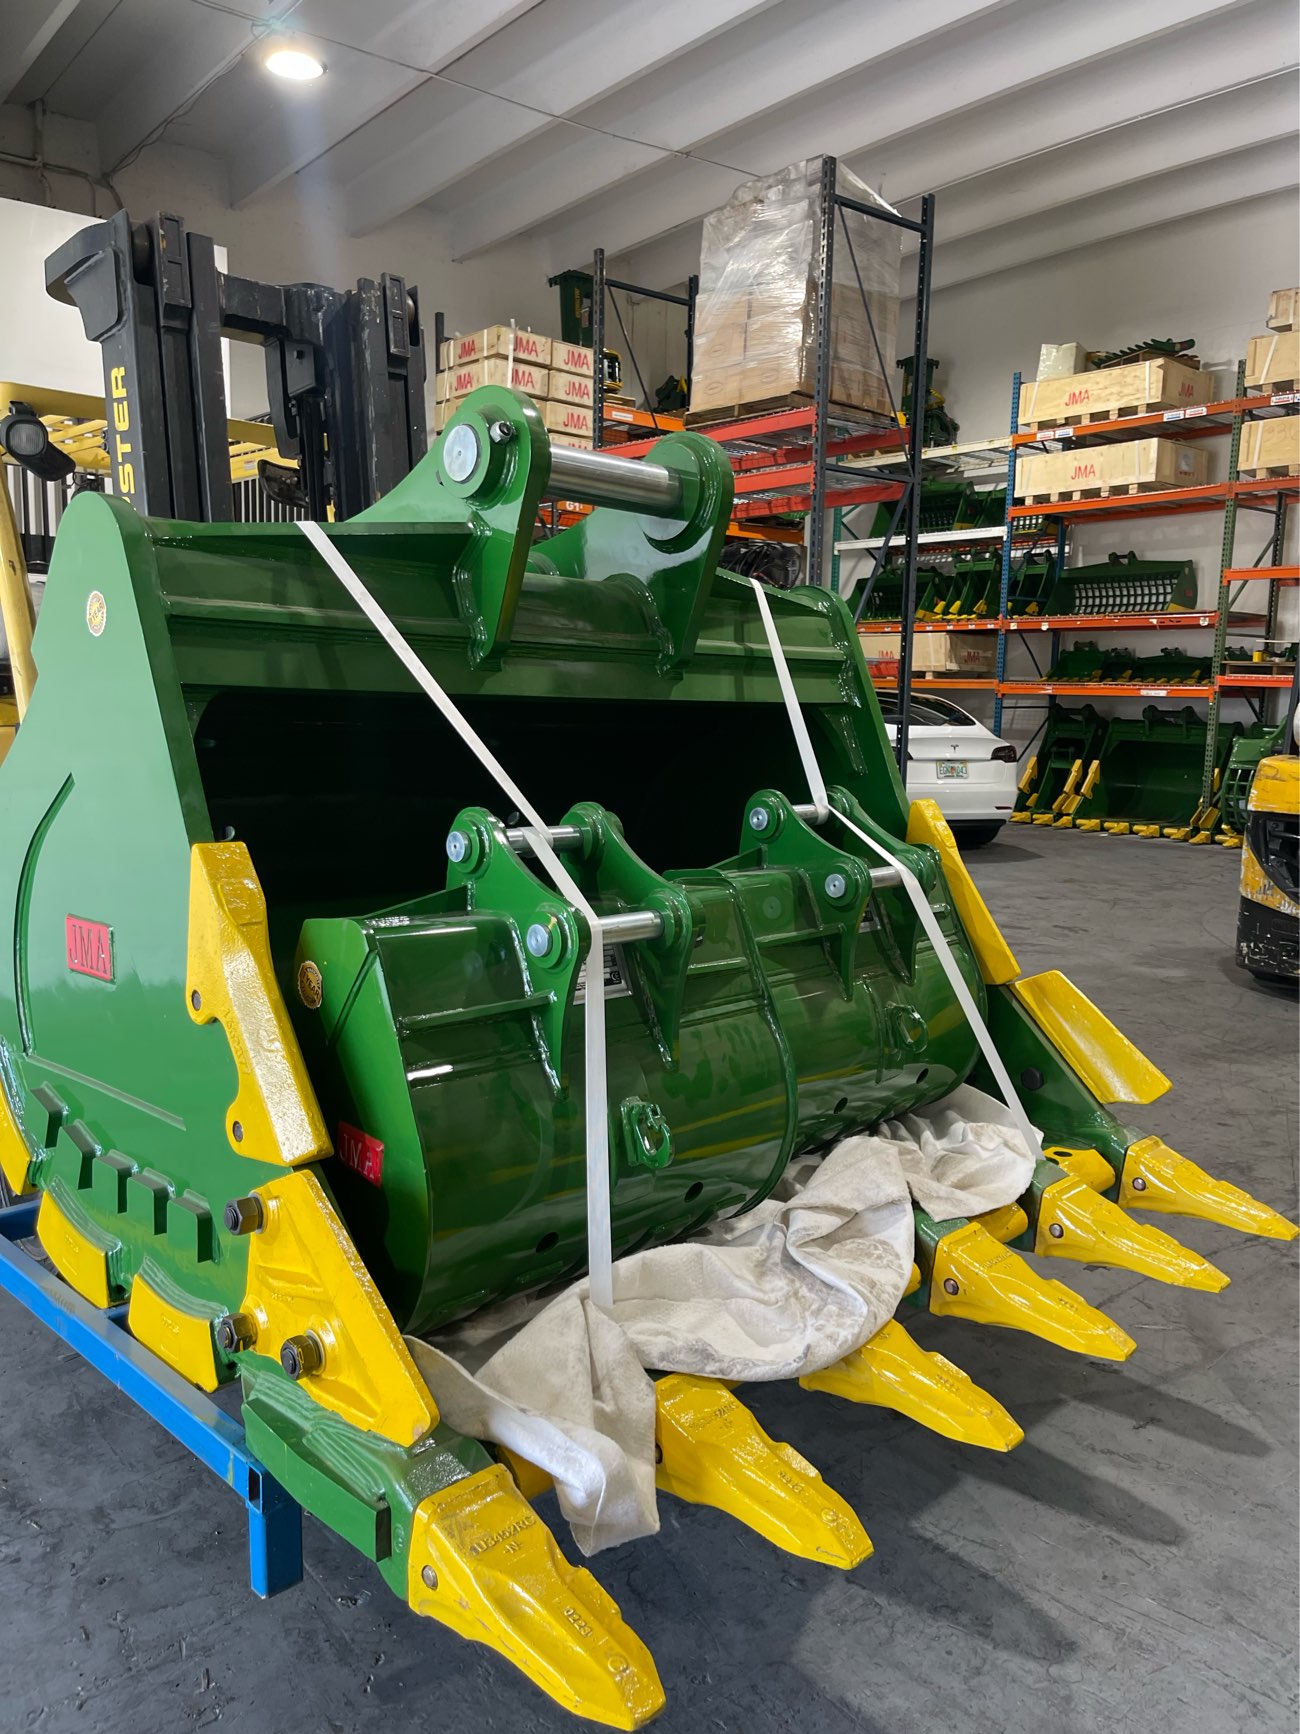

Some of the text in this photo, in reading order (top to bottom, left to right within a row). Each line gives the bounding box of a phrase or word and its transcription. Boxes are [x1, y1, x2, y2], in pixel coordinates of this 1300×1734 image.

[458, 339, 476, 359] JMA
[563, 349, 590, 371] JMA
[454, 372, 473, 392] JMA
[564, 380, 590, 400] JMA
[1178, 382, 1194, 398] JMA
[1064, 389, 1091, 407] JMA
[563, 412, 589, 432] JMA
[110, 366, 136, 508] STER
[1070, 463, 1096, 480] JMA
[69, 924, 108, 976] JMA
[339, 1133, 375, 1180] JMA
